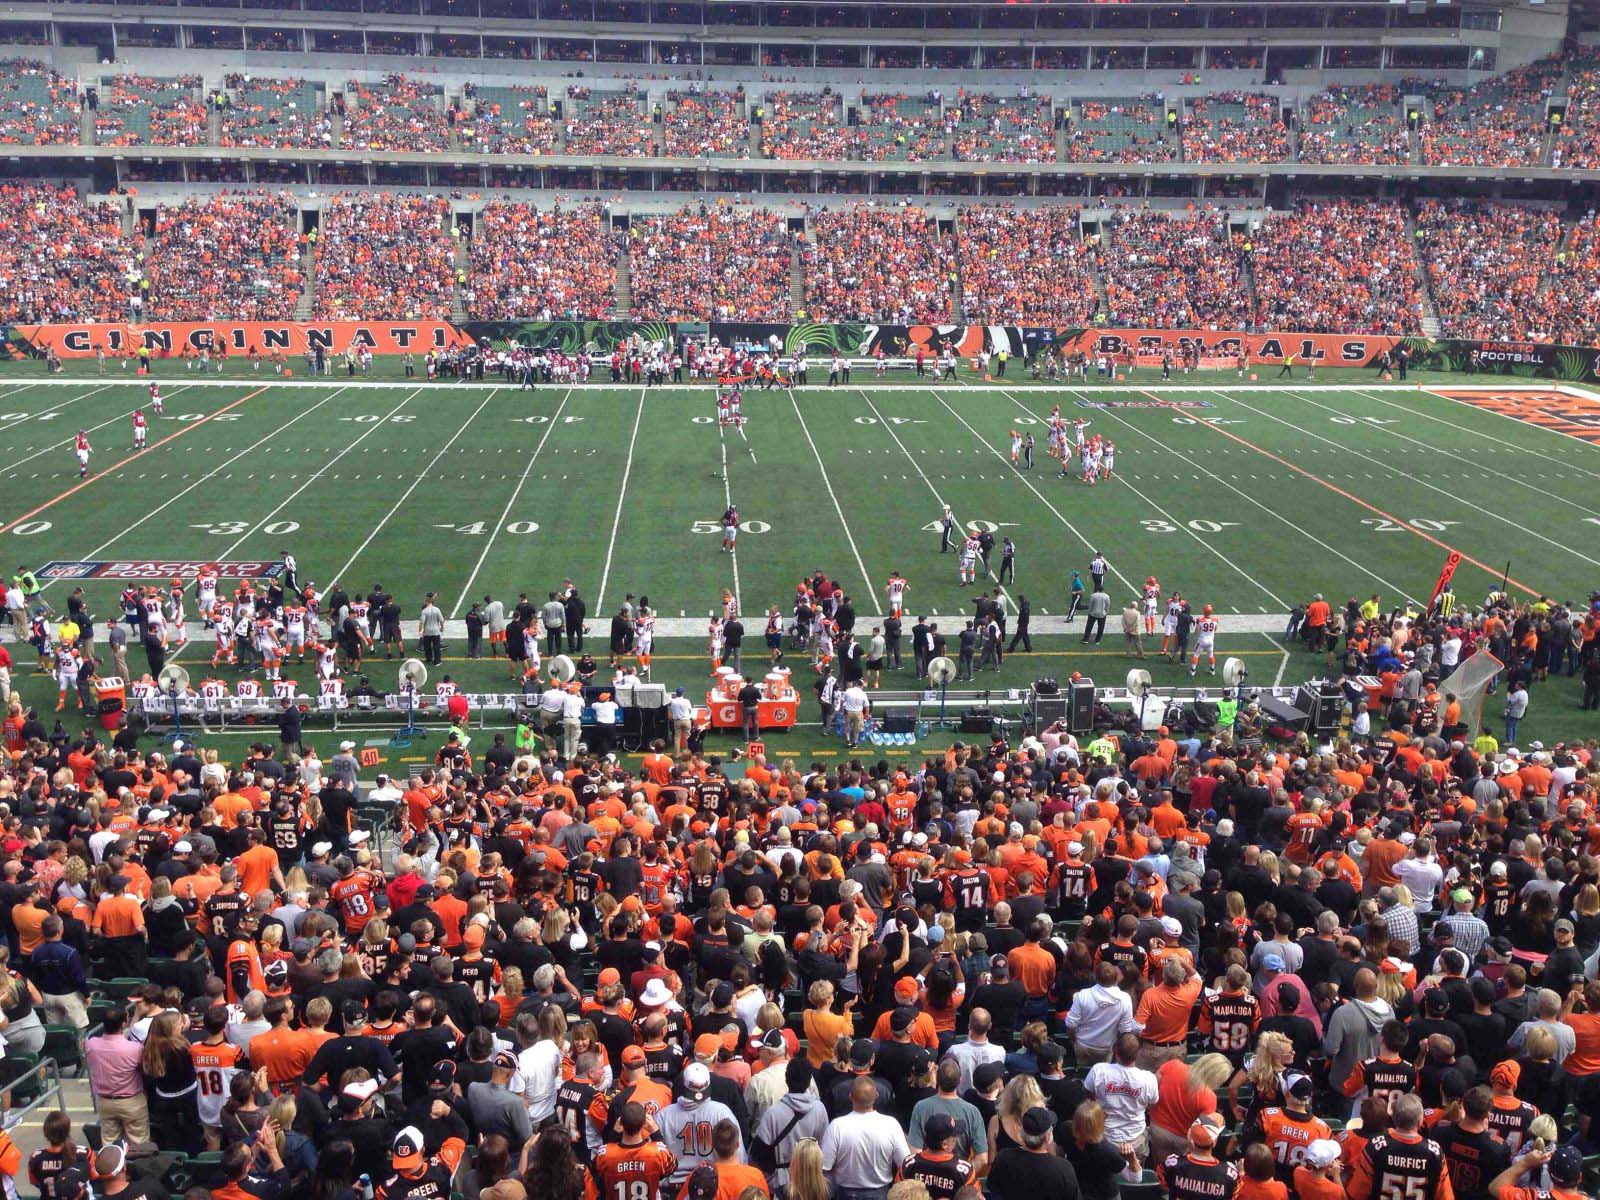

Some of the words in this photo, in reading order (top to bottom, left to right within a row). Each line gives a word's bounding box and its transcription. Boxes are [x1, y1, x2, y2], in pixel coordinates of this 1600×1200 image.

[64, 327, 447, 353] CINCINNATI
[1481, 342, 1513, 352] BACK
[1519, 345, 1535, 353] TO
[207, 521, 300, 535] 30
[456, 521, 540, 535] 40
[690, 520, 771, 534] 50
[1139, 519, 1223, 532] 30
[1360, 518, 1446, 532] 20
[106, 563, 202, 571] BACK
[216, 563, 262, 571] TO
[289, 613, 301, 623] 75
[207, 686, 219, 698] 61
[240, 684, 252, 695] 68
[720, 706, 736, 722] G
[363, 751, 378, 764] 40
[704, 794, 719, 809] 58
[1301, 828, 1315, 843] 11
[340, 884, 358, 896] GREEN
[575, 886, 589, 901] 18
[1063, 878, 1085, 898] 14
[344, 894, 368, 916] 18
[961, 886, 985, 909] 14
[1494, 899, 1508, 915] 18
[1112, 952, 1134, 961] GREEN
[462, 968, 479, 976] PEKO
[1213, 1006, 1252, 1016] MAUALUGA
[1212, 1021, 1250, 1050] 58
[196, 1055, 220, 1065] GREEN
[197, 1071, 224, 1097] 18
[1374, 1073, 1408, 1083] MAUALUGA
[1488, 1114, 1521, 1127] DALTON
[675, 1120, 714, 1157] 10
[1282, 1126, 1310, 1141] GREEN
[1372, 1135, 1388, 1150] 55
[1274, 1141, 1309, 1167] 18
[42, 1160, 63, 1170] DALT
[617, 1161, 646, 1173] GREEN
[1387, 1154, 1427, 1170] BURFICT
[915, 1172, 955, 1191] GEATHERS
[1174, 1174, 1225, 1197] MAUALUGA
[1380, 1172, 1427, 1200] 55
[408, 1181, 439, 1198] GREEN
[613, 1180, 649, 1200] 18
